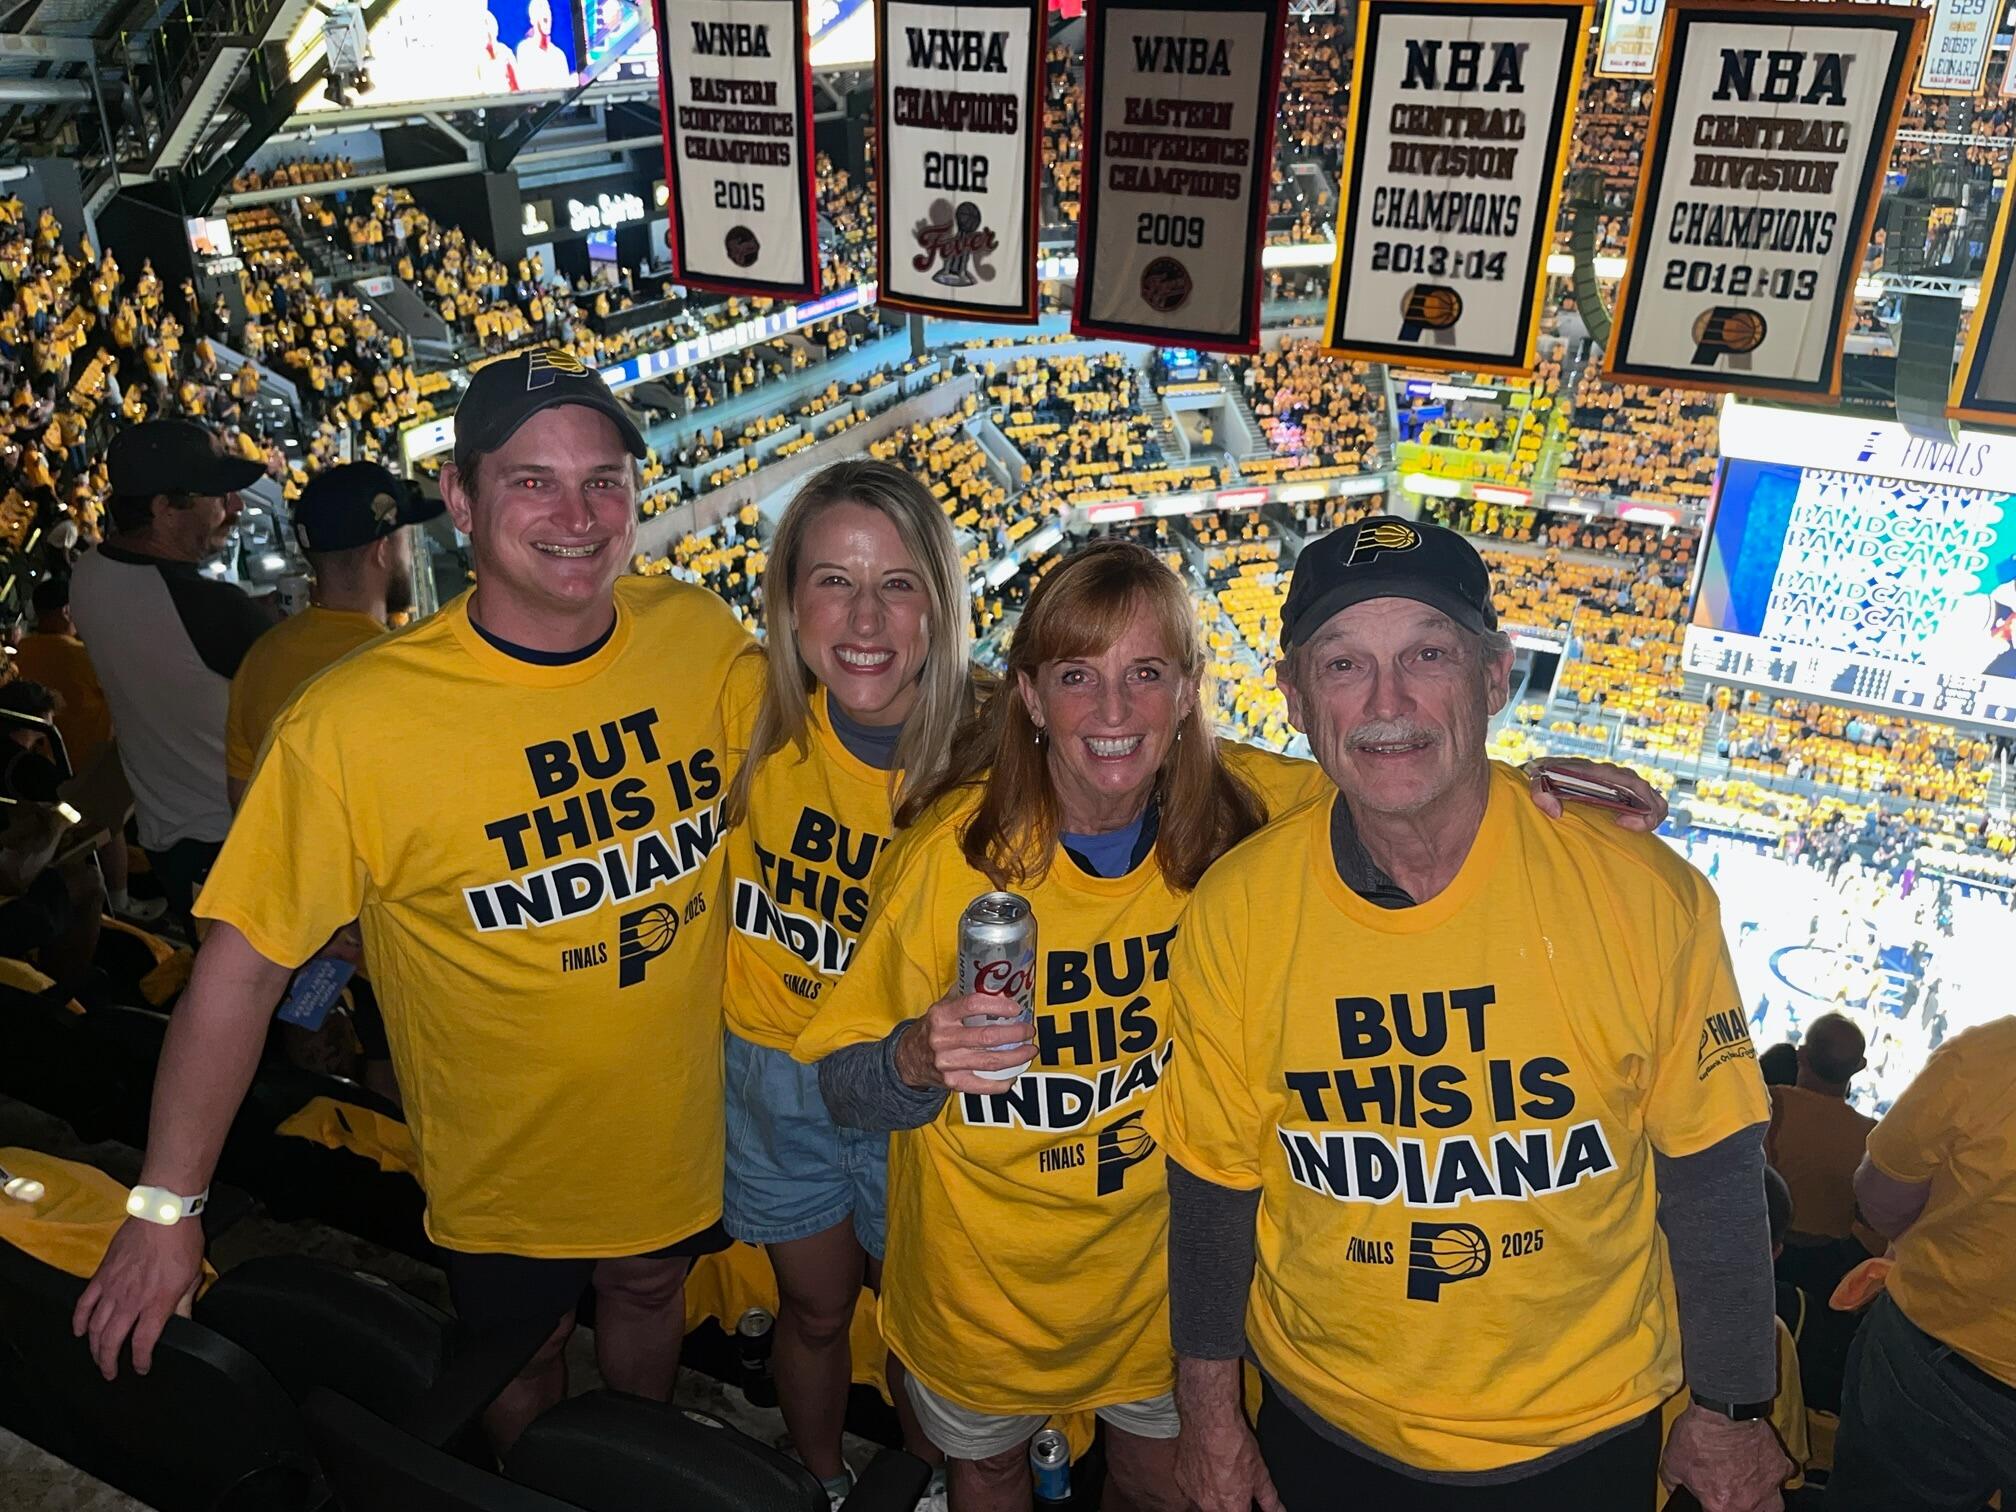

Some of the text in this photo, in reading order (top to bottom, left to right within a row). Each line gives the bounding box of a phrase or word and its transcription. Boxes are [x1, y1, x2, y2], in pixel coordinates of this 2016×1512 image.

[691, 21, 771, 58] WNBA
[905, 27, 1009, 73] WNBA
[1132, 35, 1231, 76] WNBA
[1941, 36, 1978, 55] BOBBY
[1401, 39, 1526, 93] NBA
[1712, 48, 1850, 106] NBA
[1929, 58, 1979, 77] LEONARD
[690, 77, 777, 106] EASTERN
[894, 86, 1018, 135] CHAMPIONS
[679, 106, 794, 137] CONFERENCE
[1124, 97, 1234, 130] EASTERN
[1390, 103, 1526, 141] CENTRAL
[1693, 114, 1849, 154] CENTRAL
[685, 136, 790, 166] CHAMPIONS
[1105, 130, 1249, 166] CONFERENCE
[1388, 142, 1518, 180] DIVISION
[924, 151, 988, 193] 2012
[1109, 164, 1241, 200] CHAMPIONS
[1690, 154, 1839, 194] DIVISION
[714, 180, 764, 211] 2015
[1371, 186, 1521, 237] CHAMPIONS
[912, 224, 999, 273] Fever
[1137, 213, 1204, 248] 2009
[1668, 201, 1837, 255] CHAMPIONS
[1371, 241, 1507, 281] 2013-14
[1663, 259, 1818, 301] 2012-13
[1901, 436, 1991, 477] FINALS
[1795, 506, 1995, 547] BANDCAMP
[1788, 530, 1985, 571] BANDCAMP
[524, 707, 661, 799] BUT
[484, 748, 722, 871] THIS IS
[790, 806, 892, 881] BU
[562, 942, 608, 972] FINALS
[684, 892, 706, 925] 2025
[1047, 924, 1178, 1006] BUT
[783, 973, 822, 999] FINALS
[1036, 996, 1158, 1066] HIS
[1335, 984, 1496, 1060] BUT
[1284, 1056, 1575, 1129] THIS IS
[1039, 1143, 1085, 1173] FINALS
[1277, 1119, 1618, 1208] INDIANA
[1345, 1236, 1394, 1265] FINALS
[1501, 1229, 1544, 1259] 2025
